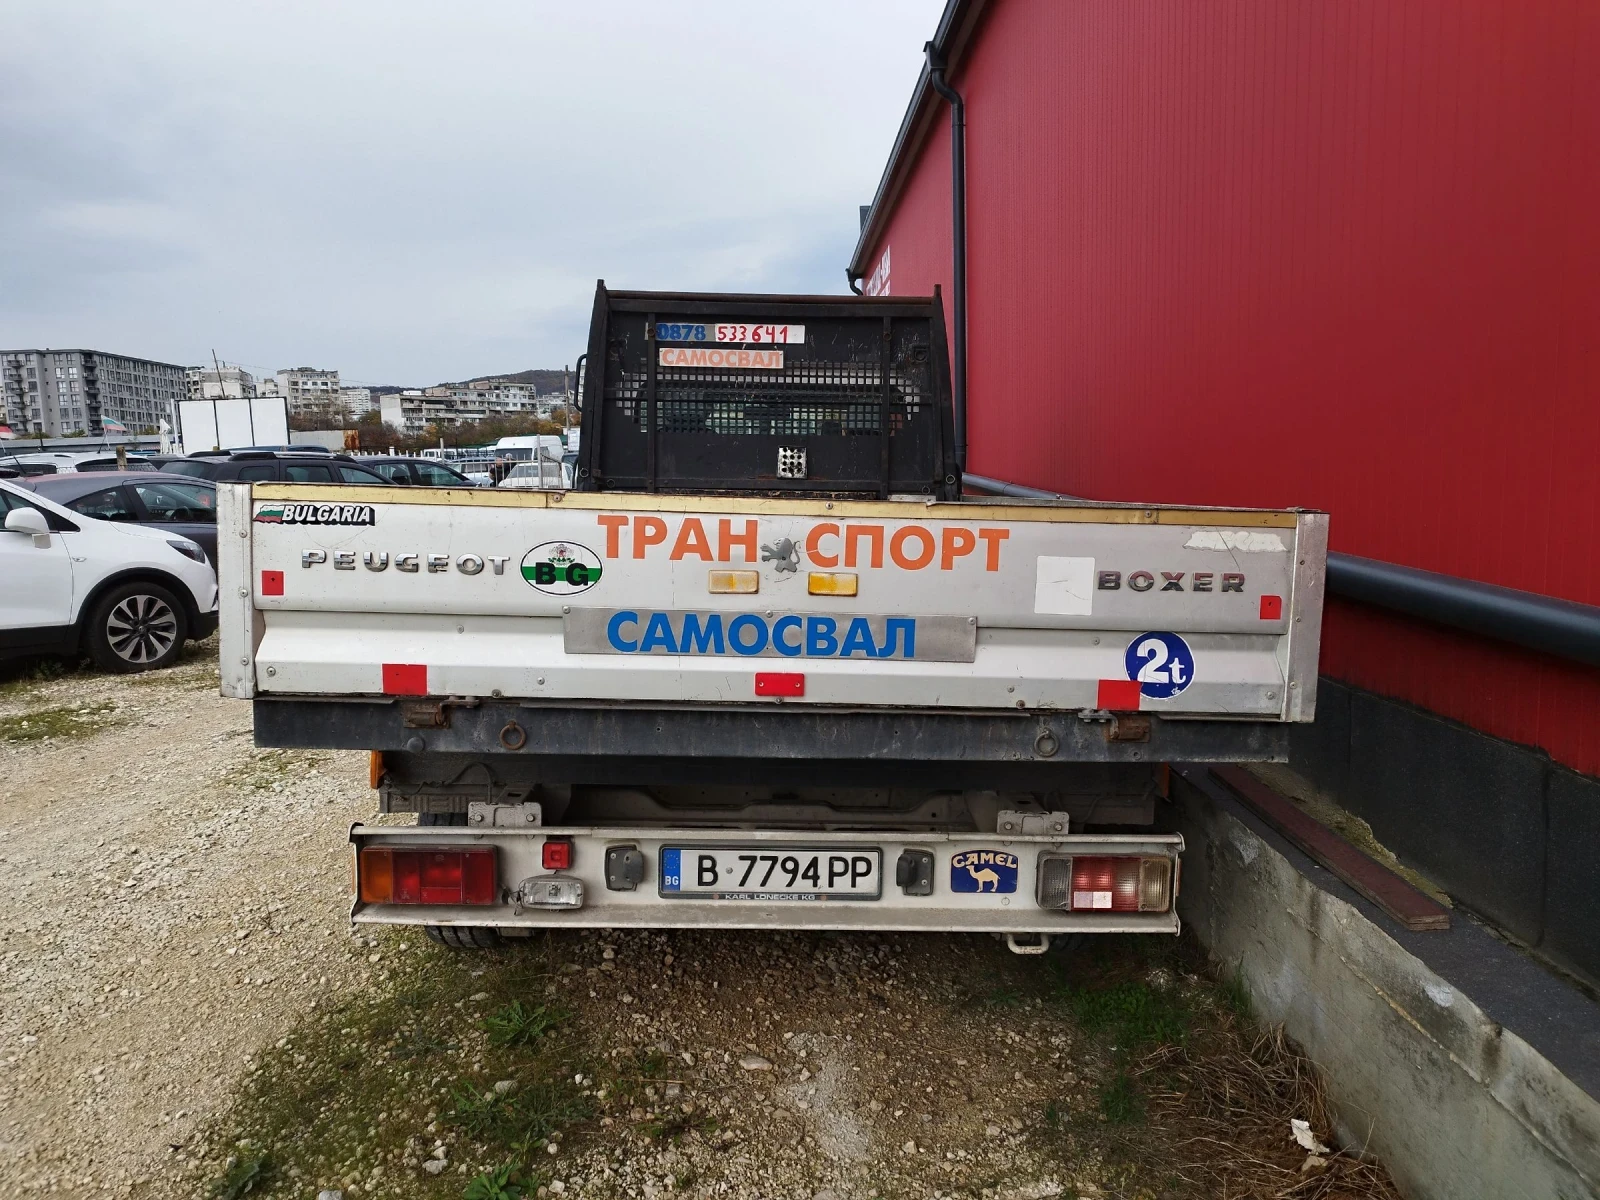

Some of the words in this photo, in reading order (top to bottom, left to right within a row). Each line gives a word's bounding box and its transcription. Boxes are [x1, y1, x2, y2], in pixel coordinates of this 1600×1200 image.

[656, 323, 706, 341] 0878
[662, 348, 781, 367] САМОСВАЛ
[281, 504, 373, 524] BULGARIA
[597, 514, 759, 563] ТРАН
[805, 522, 1010, 572] СПОРТ
[301, 549, 510, 576] PEUGEOT
[535, 561, 589, 586] BG
[1097, 570, 1245, 593] BOXER
[606, 610, 916, 659] САМОСВАЛ
[1136, 638, 1187, 685] 2t
[952, 852, 1017, 868] CAMEL
[664, 875, 679, 886] BG
[725, 893, 751, 901] KARL
[801, 893, 816, 901] KG
